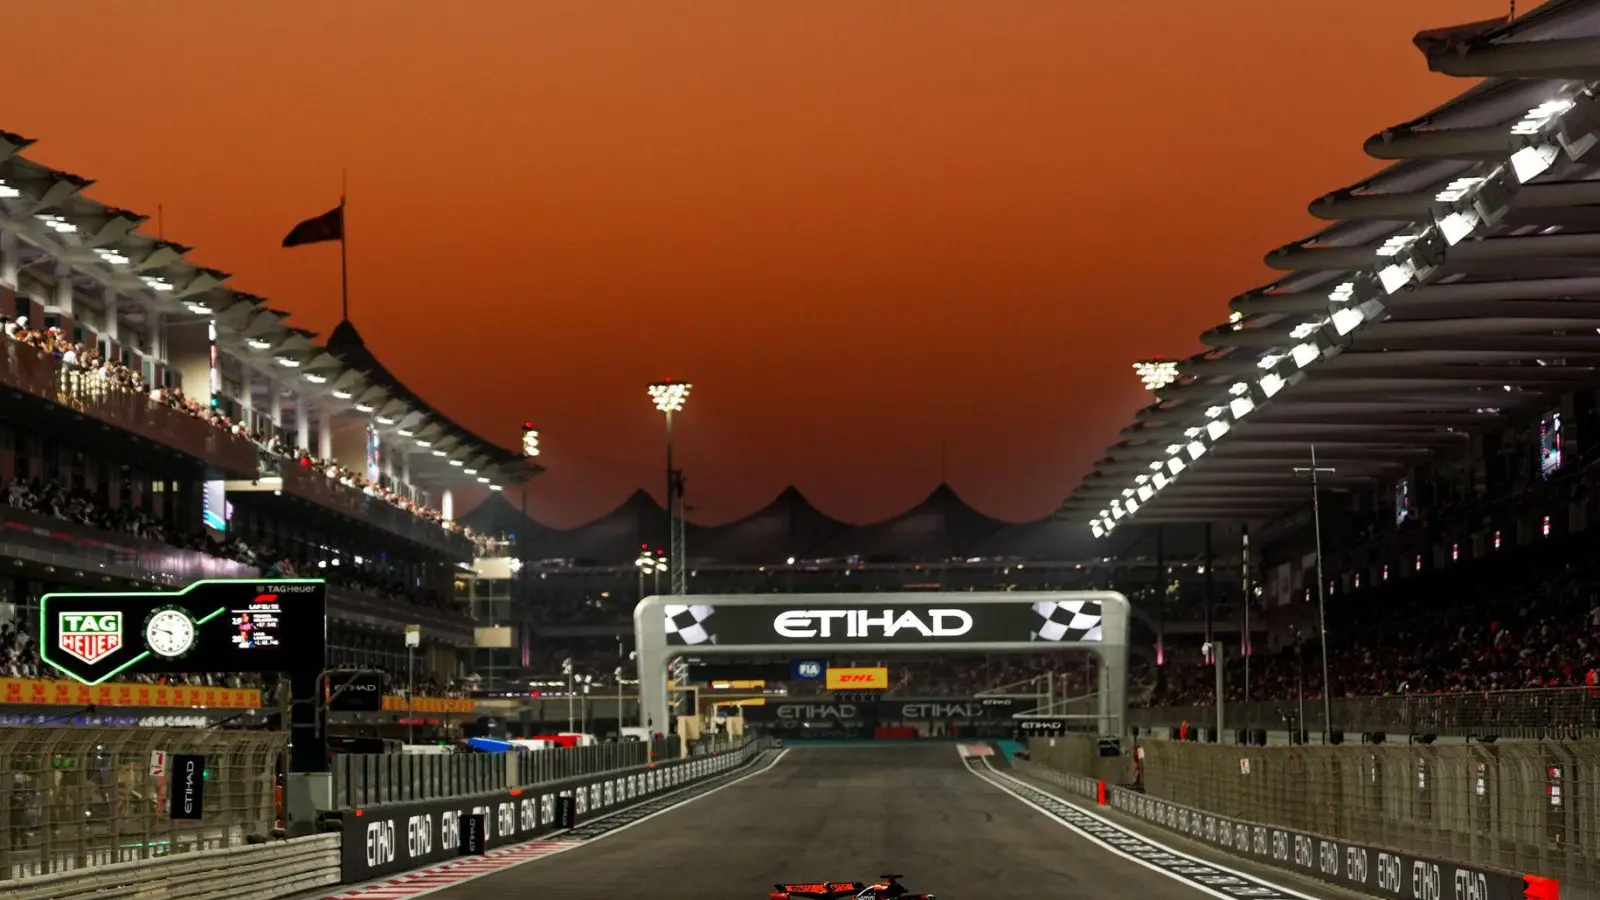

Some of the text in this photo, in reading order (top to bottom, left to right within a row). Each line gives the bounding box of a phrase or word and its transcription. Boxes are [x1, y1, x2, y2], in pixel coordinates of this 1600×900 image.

[64, 615, 117, 631] TAG
[773, 608, 973, 638] ETIHAD
[63, 635, 118, 659] HEUER
[799, 664, 819, 675] FIA
[840, 674, 874, 682] DHL
[777, 705, 856, 718] ETIHAD
[902, 704, 983, 717] ETIHAD
[184, 761, 194, 813] ETIHAD
[367, 819, 395, 868] ETIHAD
[408, 813, 432, 858] ETIHAD
[1346, 846, 1368, 883] ETIHAD
[1377, 852, 1401, 893] ETIHAD
[1412, 860, 1440, 900] ETIHAD
[1455, 868, 1488, 900] ETIHAD
